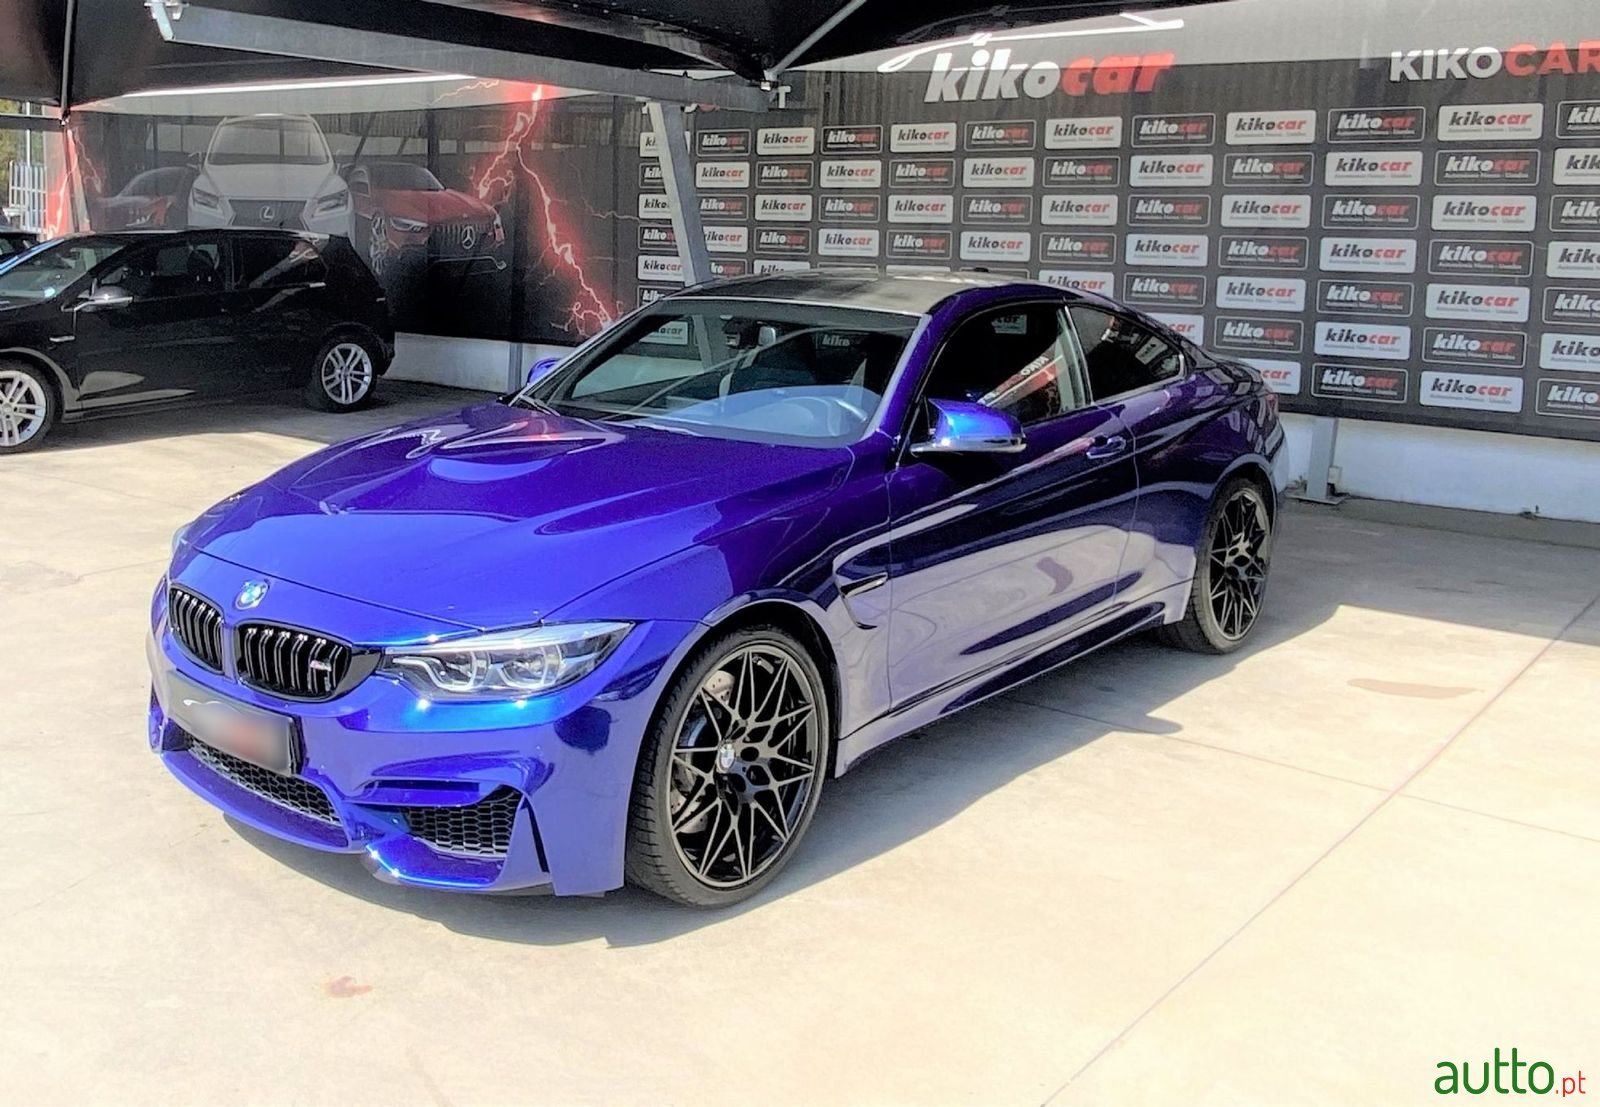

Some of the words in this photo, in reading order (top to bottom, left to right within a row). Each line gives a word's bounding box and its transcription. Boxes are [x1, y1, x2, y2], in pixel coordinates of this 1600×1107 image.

[1389, 39, 1600, 81] KIKOCAR
[924, 49, 1174, 102] kikocar
[1235, 117, 1306, 131] kikocar
[1337, 113, 1416, 129] kikocar
[1450, 111, 1533, 126] kikocar
[972, 126, 1028, 140] kikocar
[1054, 123, 1114, 136] kikocar
[1140, 120, 1207, 134] kikocar
[763, 133, 808, 144] kikocar
[828, 131, 877, 143] kikocar
[897, 129, 949, 141] kikocar
[896, 164, 948, 177] kikocar
[971, 163, 1026, 175] kikocar
[1051, 161, 1113, 176] kikocar
[1138, 160, 1204, 174] kikocar
[1232, 158, 1304, 174] kikocar
[1336, 158, 1412, 172] kikocar
[1445, 155, 1530, 172] kikocar
[761, 166, 808, 179] kikocar
[827, 166, 875, 177] kikocar
[761, 200, 806, 211] kikocar
[825, 199, 874, 212] kikocar
[895, 200, 946, 211] kikocar
[968, 200, 1025, 214] kikocar
[1050, 200, 1110, 213] kikocar
[1136, 200, 1202, 214] kikocar
[1231, 200, 1301, 214] kikocar
[1332, 200, 1409, 216] kikocar
[1443, 201, 1526, 216] kikocar
[1562, 201, 1600, 217] kik
[760, 232, 806, 244] kikocar
[825, 233, 872, 245] kikocar
[893, 235, 945, 249] kikocar
[968, 237, 1023, 249] kikocar
[1047, 237, 1109, 252] kikocar
[1135, 239, 1200, 253] kikocar
[1228, 241, 1299, 256] kikocar
[1330, 243, 1406, 258] kikocar
[1439, 245, 1522, 262] kikocar
[1131, 278, 1197, 293] kikocar
[1226, 282, 1296, 297] kikocar
[1327, 285, 1404, 302] kikocar
[1437, 290, 1519, 307] kikocar
[1223, 322, 1294, 339] kikocar
[1325, 328, 1400, 345] kikocar
[1433, 333, 1516, 353] kikocar
[1321, 369, 1398, 389] kikocar
[1431, 378, 1512, 397] kikocar
[1547, 385, 1600, 403] kiko
